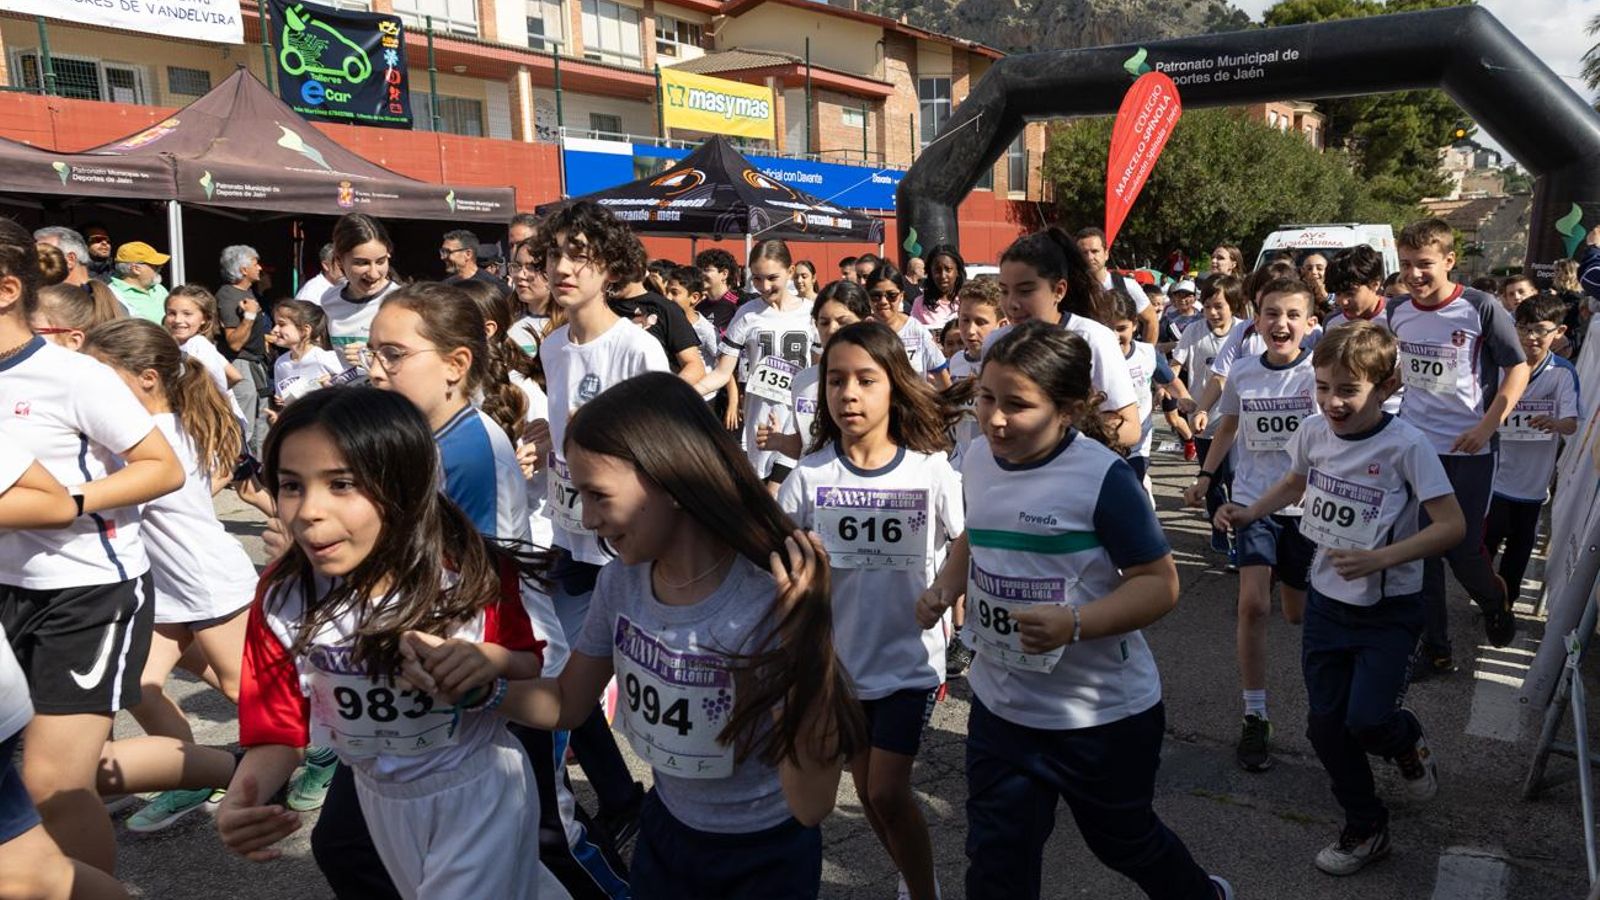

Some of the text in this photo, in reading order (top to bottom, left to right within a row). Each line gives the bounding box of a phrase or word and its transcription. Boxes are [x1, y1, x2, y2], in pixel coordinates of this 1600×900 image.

[120, 0, 139, 12] DE
[145, 3, 235, 25] VANDELVIRA
[1155, 49, 1300, 73] Patronato Municipal de
[1171, 66, 1264, 86] portes de Jaén
[688, 88, 769, 119] masymas
[1135, 84, 1162, 134] COLEGIO
[72, 166, 106, 175] Patronato
[72, 173, 105, 183] Deportes
[783, 171, 797, 182] con
[797, 170, 823, 184] Davante
[1116, 141, 1146, 197] MARCELO
[216, 182, 244, 191] Patronato
[244, 184, 271, 193] Municipal
[216, 188, 243, 198] Deportes
[1410, 358, 1444, 377] 870
[758, 369, 793, 392] 135
[1257, 415, 1299, 433] 606
[555, 481, 579, 509] 07
[1019, 512, 1058, 526] Poveda
[1311, 496, 1355, 527] 609
[838, 516, 902, 543] 616
[1006, 588, 1052, 599] LA GLORIA
[979, 599, 1020, 635] 98
[674, 669, 715, 684] GLORIA
[333, 686, 434, 723] 983
[626, 672, 693, 736] 994
